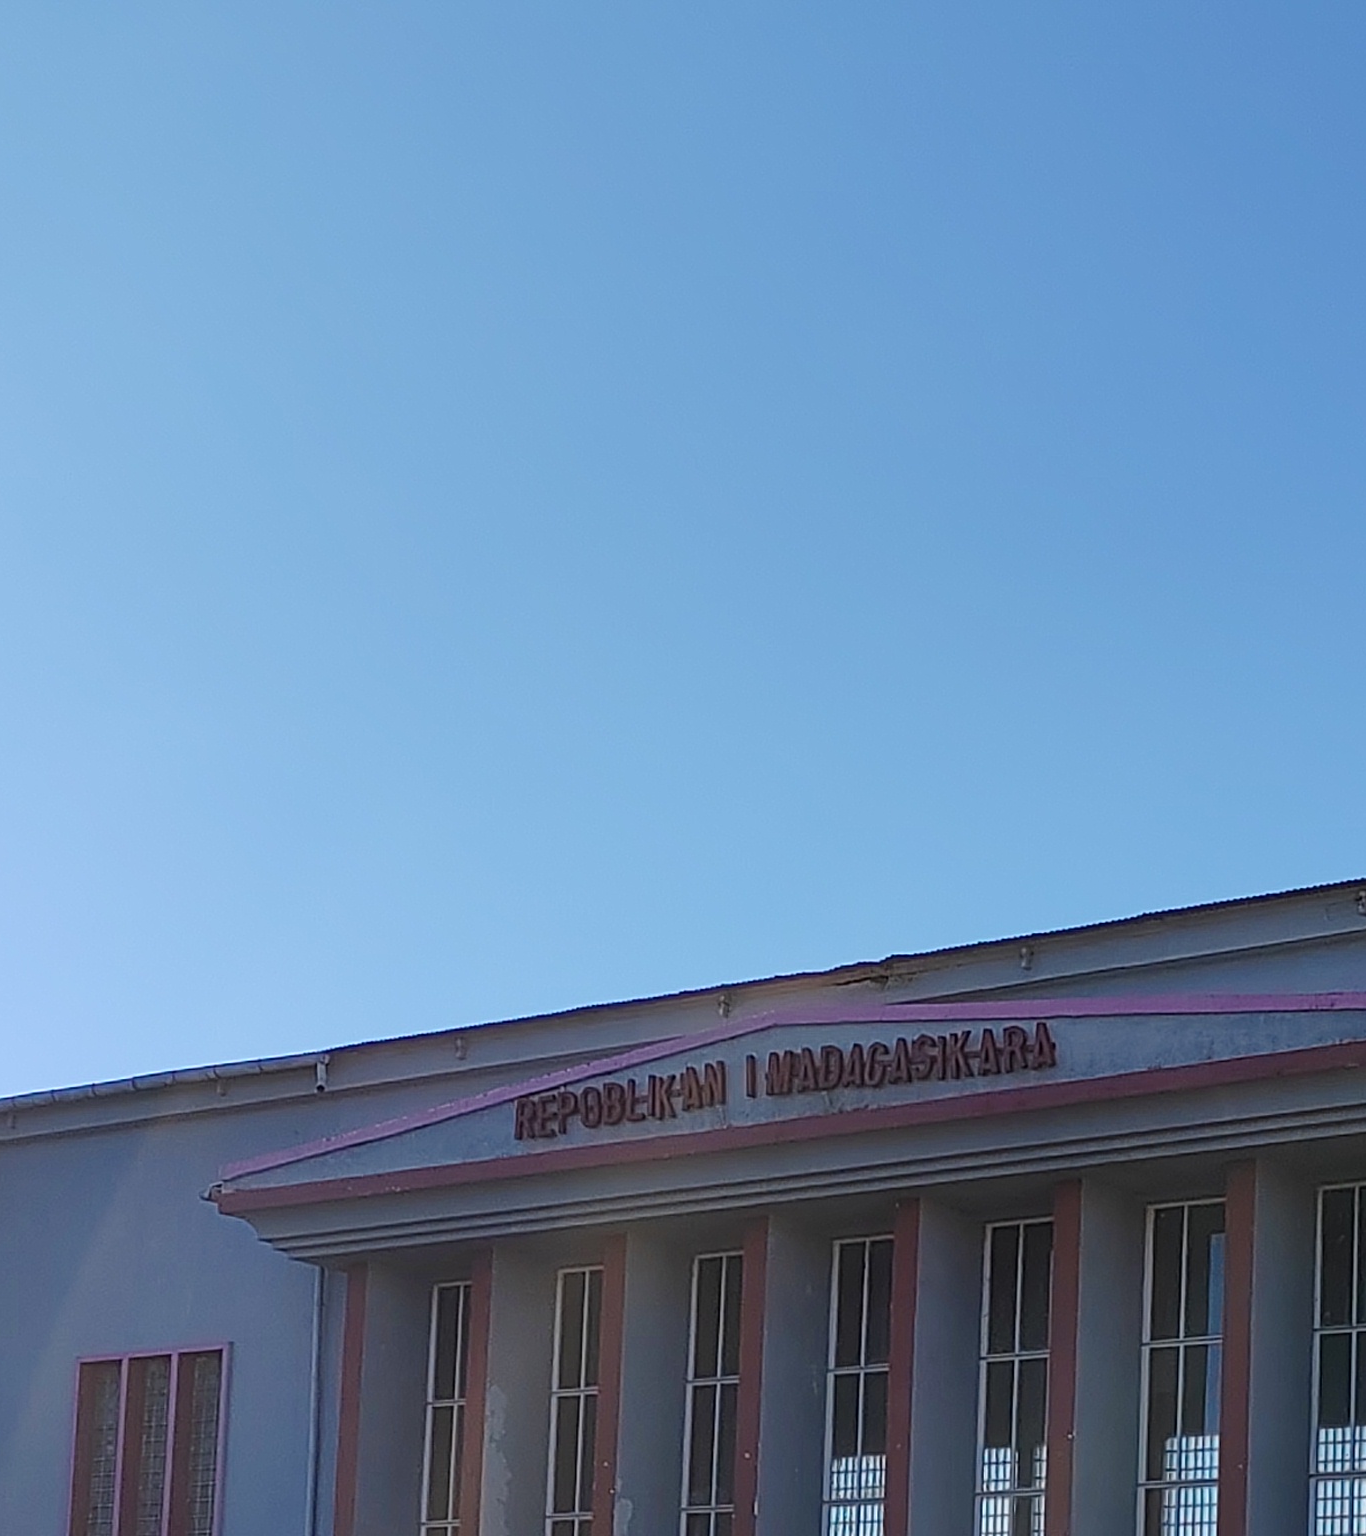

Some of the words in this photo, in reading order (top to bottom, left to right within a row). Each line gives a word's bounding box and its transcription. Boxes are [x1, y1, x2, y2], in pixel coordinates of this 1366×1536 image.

[513, 1060, 727, 1142] REPOBLIKAN
[744, 1053, 757, 1098] I
[764, 1021, 1057, 1096] MADAGASIKARA
